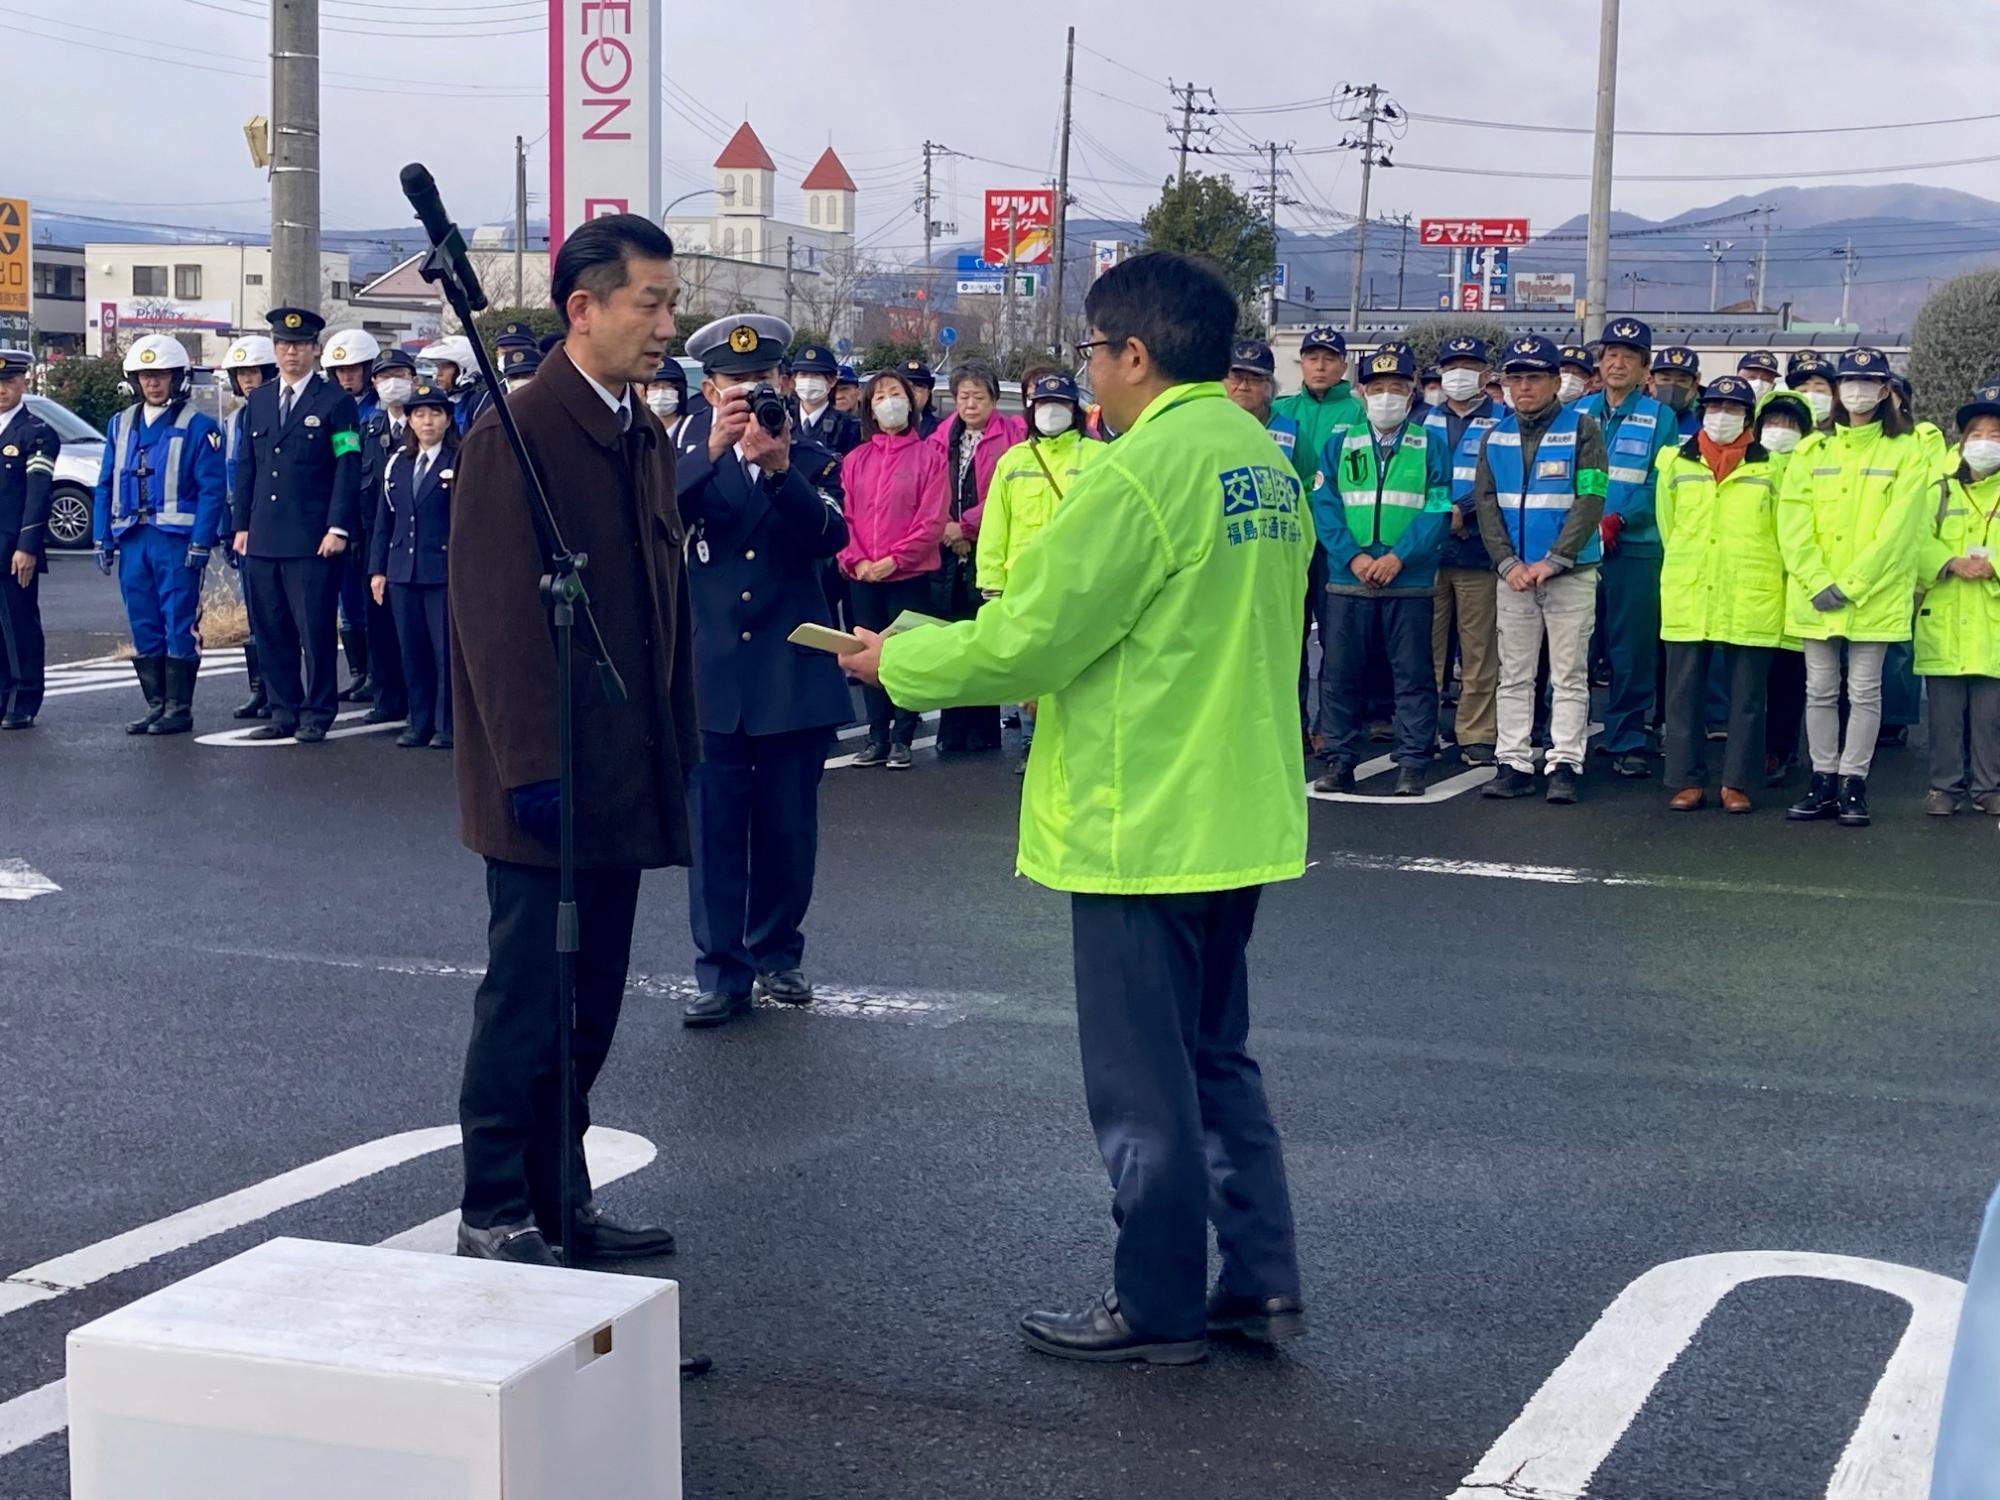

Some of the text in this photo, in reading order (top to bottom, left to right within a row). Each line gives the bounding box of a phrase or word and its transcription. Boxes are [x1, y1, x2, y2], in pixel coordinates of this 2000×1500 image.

[581, 0, 632, 140] EON
[991, 196, 1049, 215] ツルハ
[1425, 222, 1524, 243] タマホーム
